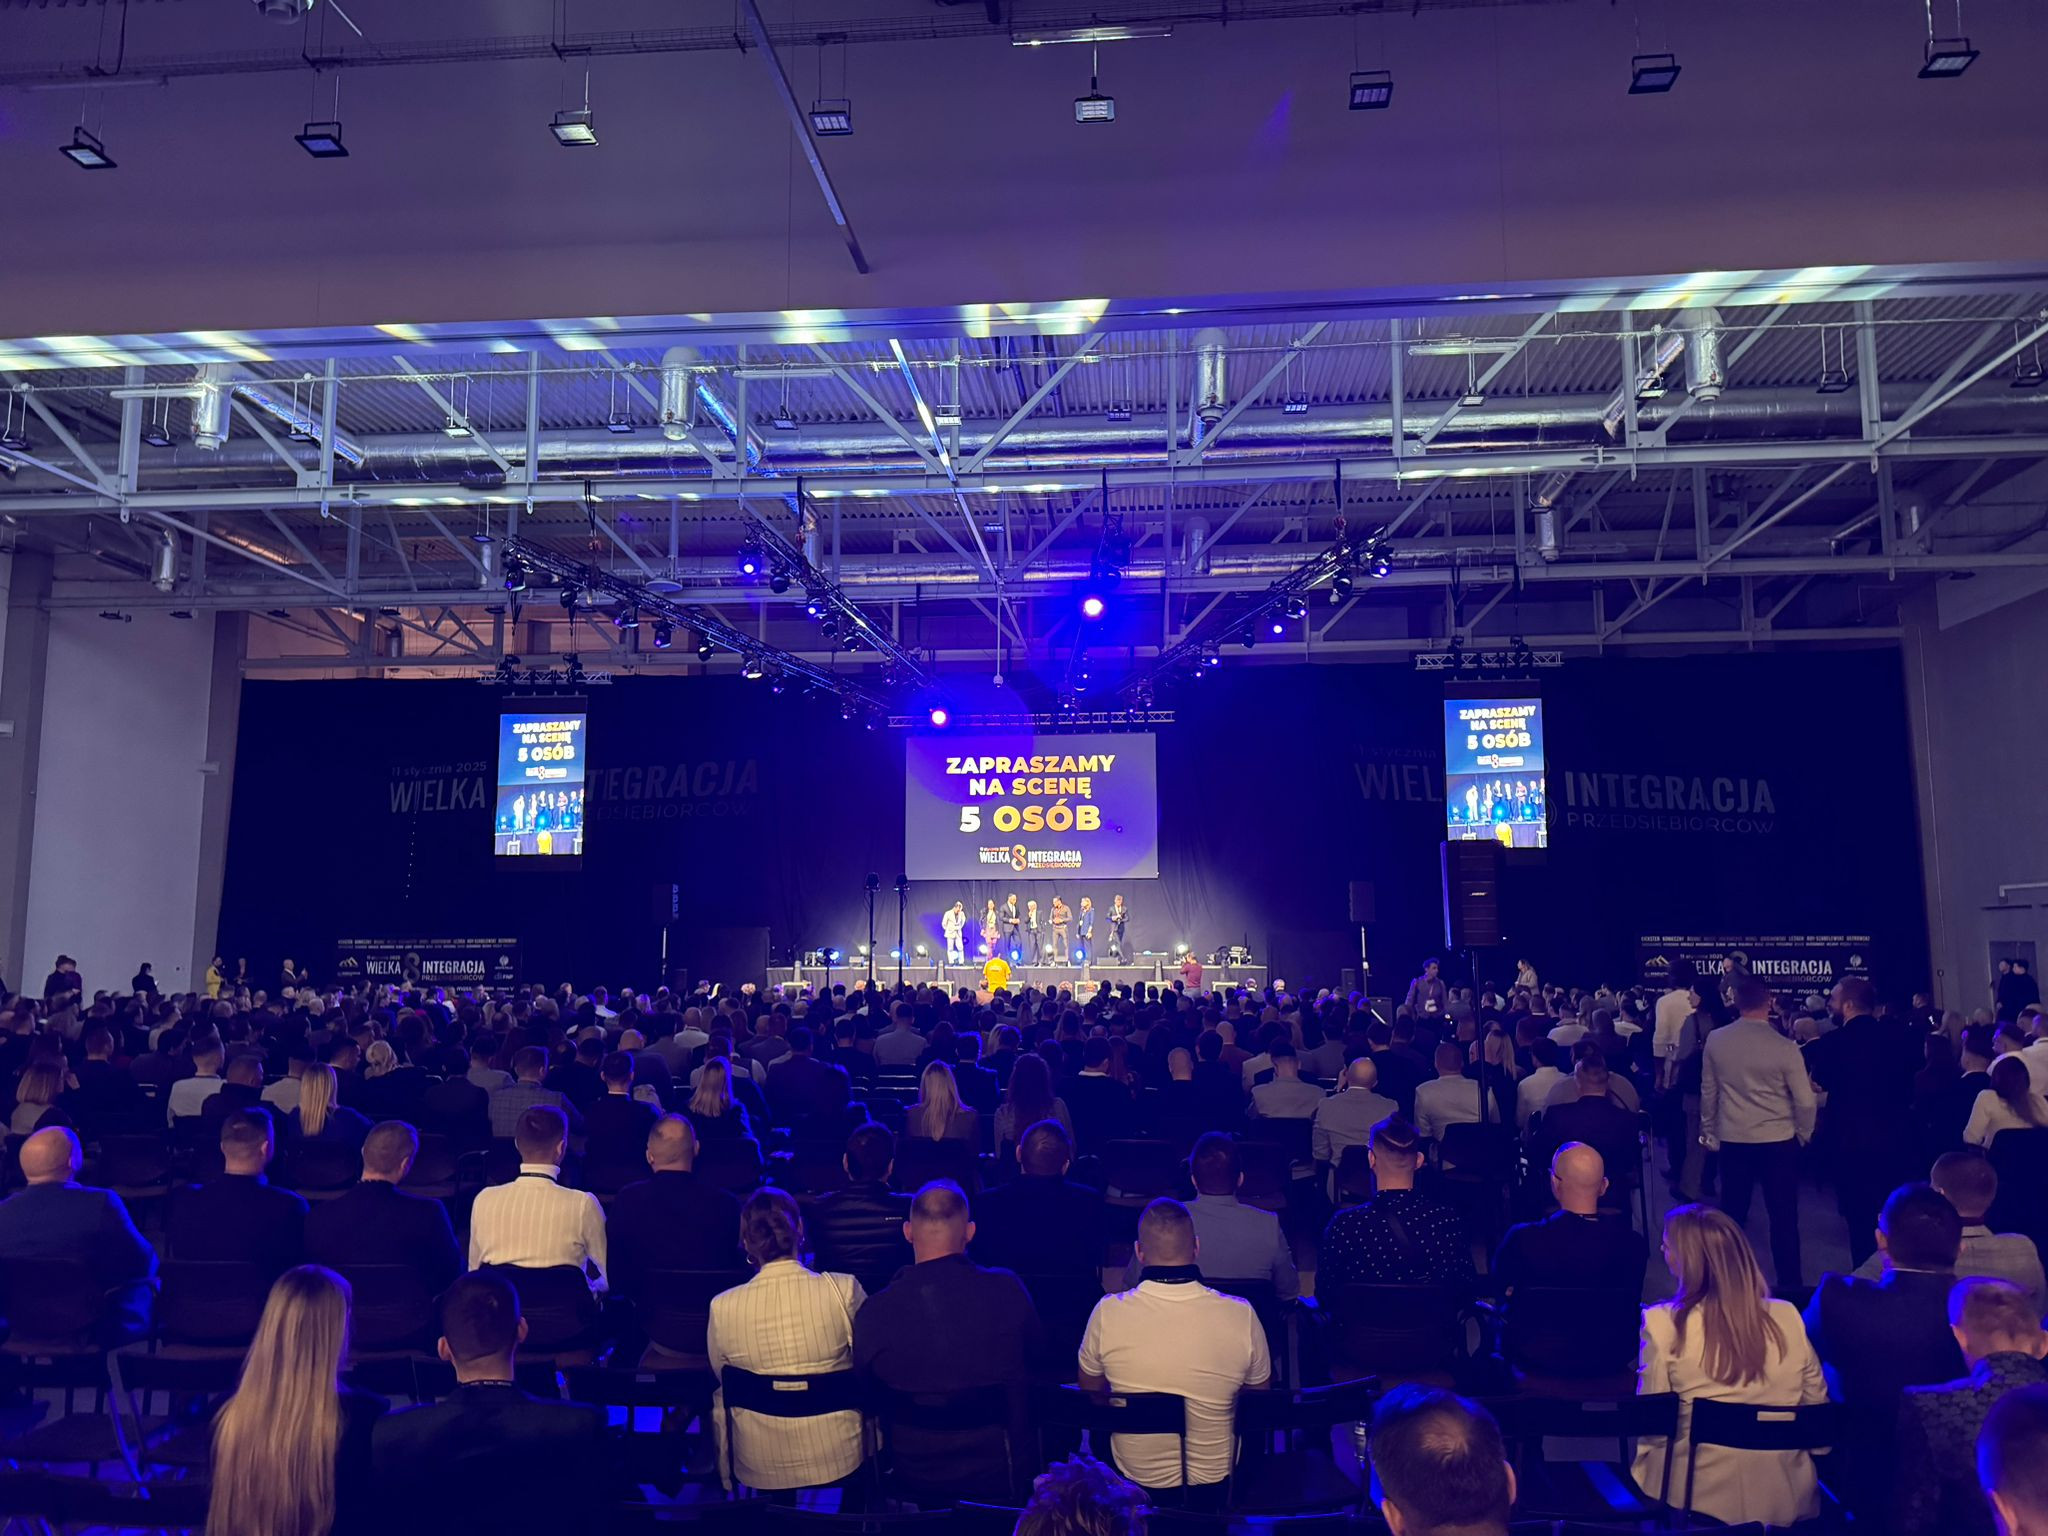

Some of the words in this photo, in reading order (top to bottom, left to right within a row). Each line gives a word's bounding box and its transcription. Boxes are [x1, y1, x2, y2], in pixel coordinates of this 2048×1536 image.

[1459, 705, 1536, 720] ZAPRASZAMY
[513, 720, 581, 734] ZAPRASZAMY
[1470, 719, 1488, 731] NA
[1489, 717, 1526, 731] SCENĘ
[522, 733, 538, 744] NA
[538, 732, 572, 744] SCENĘ
[1467, 734, 1478, 750] 5
[1482, 729, 1531, 749] OSÓB
[517, 747, 528, 762] 5
[531, 742, 575, 762] OSÓB
[455, 761, 487, 773] 2025
[946, 755, 1116, 775] ZAPRASZAMY
[390, 777, 486, 814] WIELKA
[586, 759, 759, 802] TEGRACJA
[969, 778, 1005, 796] NA
[1012, 777, 1092, 799] SCENĘ
[1353, 762, 1443, 802] WIEL
[1564, 770, 1776, 814] INTEGRACJA
[959, 805, 981, 833] 5
[993, 799, 1101, 833] OSÓB
[980, 852, 1010, 864] WIELKA
[1028, 851, 1083, 863] INTEGRACJA
[366, 960, 401, 975] WIELKA
[423, 960, 486, 975] INTEGRACJA
[1693, 960, 1725, 975] ELKA
[1752, 959, 1833, 975] INTEGRACJA
